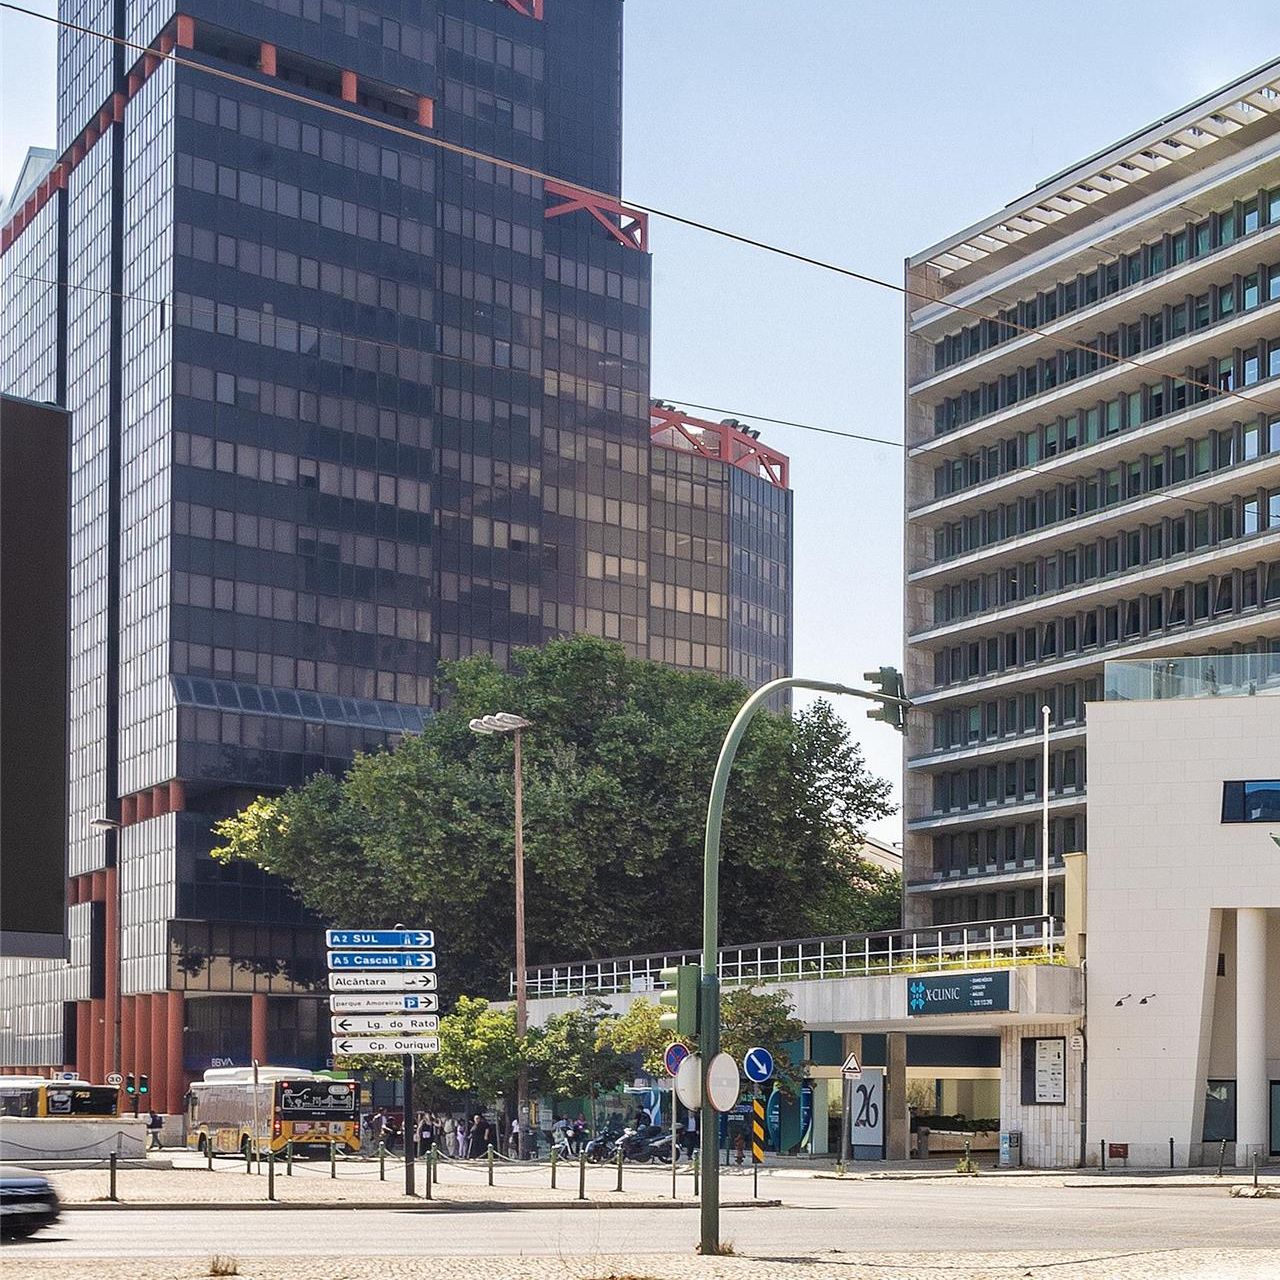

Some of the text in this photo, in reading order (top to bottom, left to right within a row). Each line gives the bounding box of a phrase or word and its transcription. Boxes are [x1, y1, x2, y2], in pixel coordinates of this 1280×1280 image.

[332, 934, 378, 943] A2 SUL
[334, 955, 398, 964] A5 Cascais
[335, 977, 386, 986] Alcântara
[926, 987, 960, 1001] X-CLINIC
[390, 1020, 403, 1028] do
[411, 1019, 435, 1027] Rato
[370, 1040, 436, 1050] Cp. Ourique
